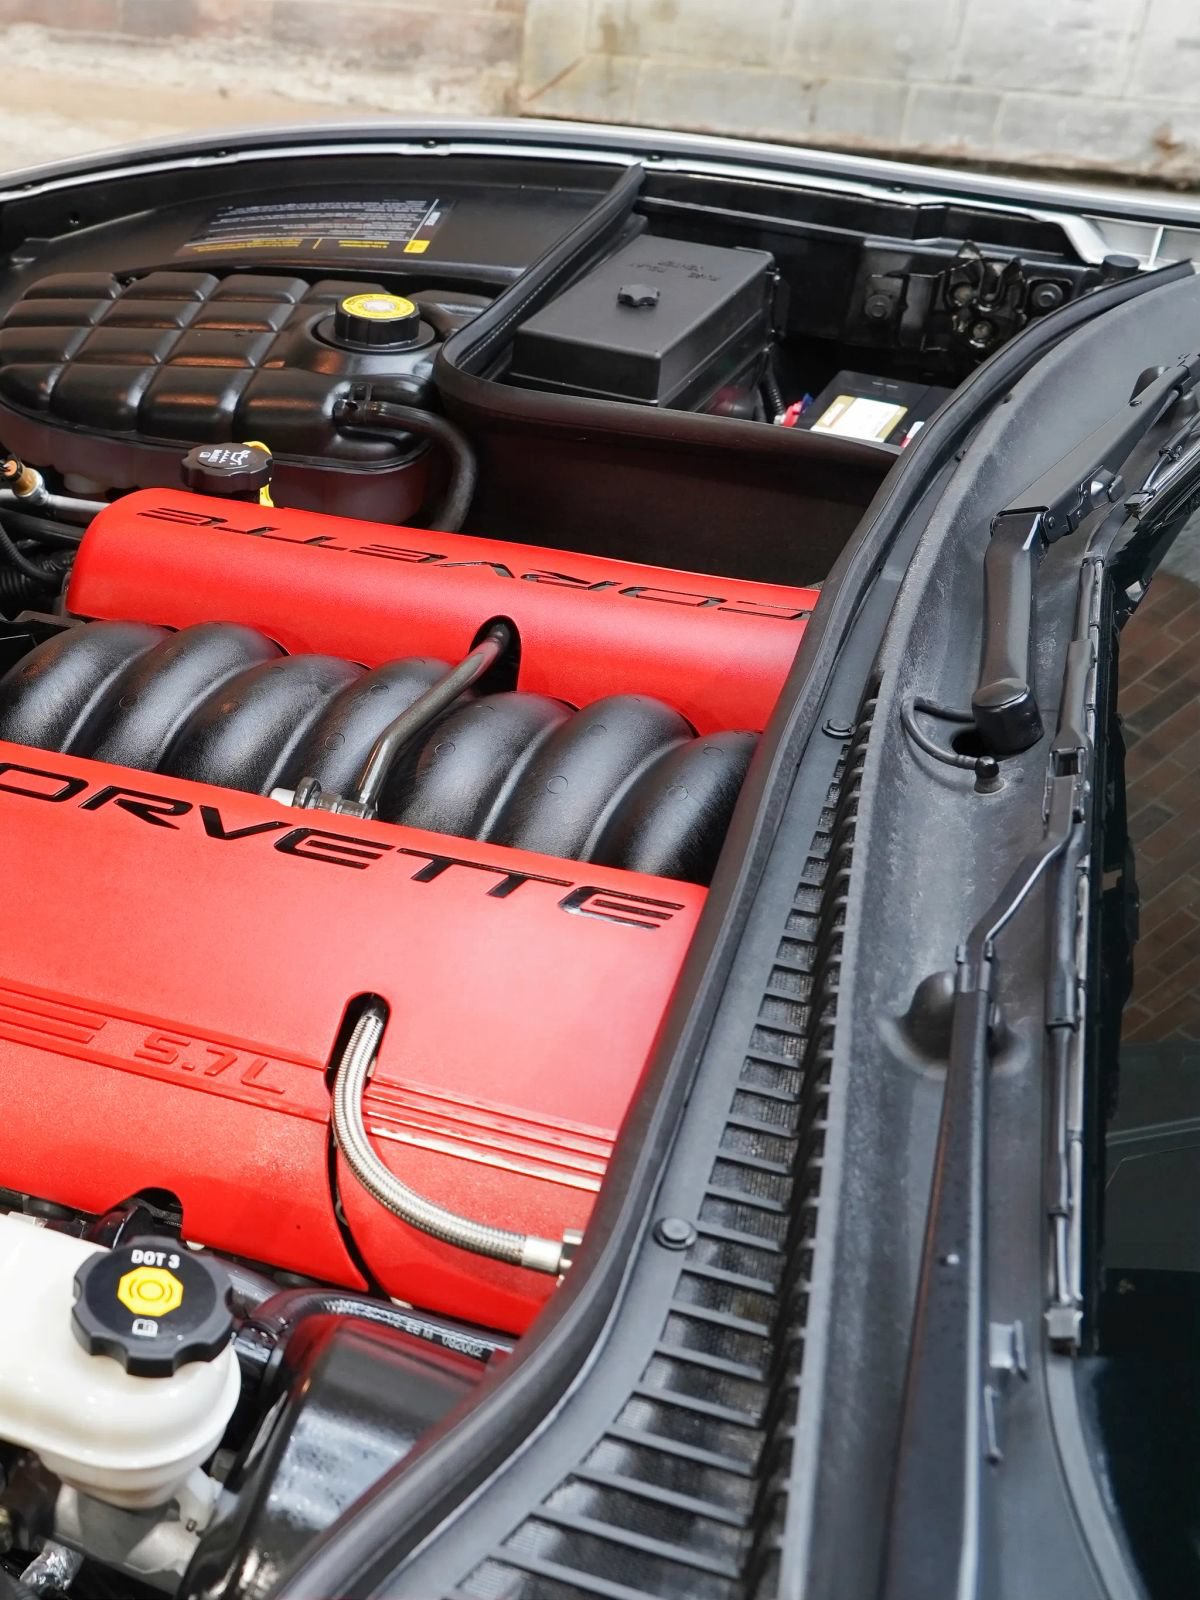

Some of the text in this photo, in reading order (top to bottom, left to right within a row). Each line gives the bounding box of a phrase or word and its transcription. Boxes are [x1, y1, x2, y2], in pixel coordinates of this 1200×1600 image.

[136, 506, 812, 621] CORVETTE
[134, 1032, 286, 1095] 5.7L
[131, 1249, 180, 1269] DOT 3
